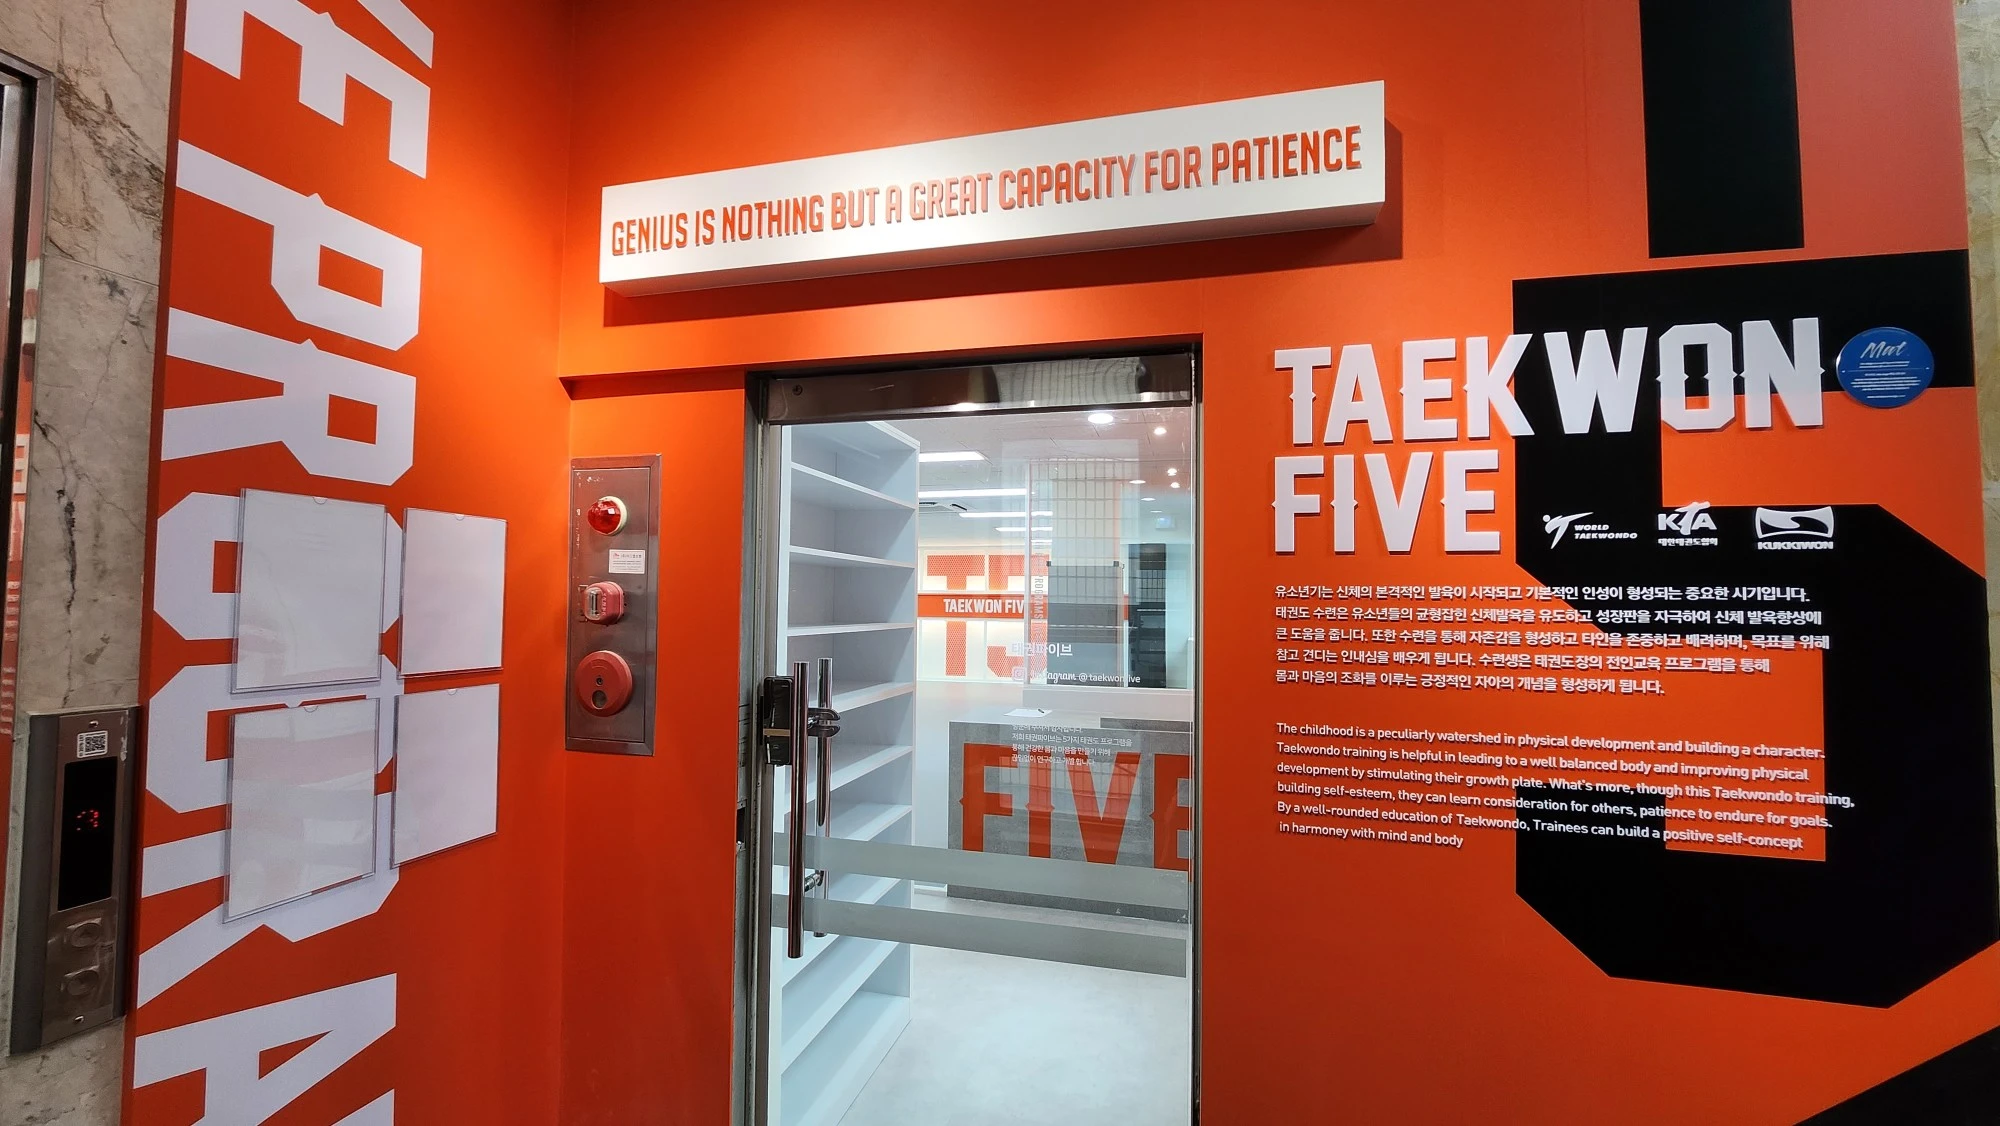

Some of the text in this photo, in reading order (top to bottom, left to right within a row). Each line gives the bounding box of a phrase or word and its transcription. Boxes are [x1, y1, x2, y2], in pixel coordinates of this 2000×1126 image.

[612, 125, 1362, 256] GENIUS IS NOTHING BUT A GREAT CAPACITY FOR PATIENCE
[1273, 317, 1826, 446] TAEKWON
[1271, 449, 1501, 555] FIVE
[1657, 501, 1717, 536] KTA
[1574, 532, 1638, 540] TAEKWONDO
[1757, 541, 1834, 550] KUKKIWON
[943, 598, 1025, 614] TAEKWON FIV
[1274, 584, 1811, 603] 유소년기는 신체의 본격적인 발육이 시작되고 기본적인 인성이 형성되는 중요한 시기입니다.
[1275, 606, 1822, 626] 태권도 수련은 유소년들의 균형잡힌 신체발육을 유도하고 성장판을 자극하여 신체 발육향상에
[1275, 627, 1830, 650] 큰 도움을 줍니다. 또한 수련을 통해 자존감을 형성하고 타인을 존중하고 배려하며, 목표를 위해
[1276, 648, 1300, 661] 참고
[1302, 649, 1338, 663] 견디는
[1340, 649, 1390, 664] 인내심을
[1392, 651, 1431, 665] 배우게
[1433, 652, 1476, 666] 됩니다.
[1478, 653, 1533, 668] 수련생은
[1605, 655, 1663, 671] 전인교육
[1664, 656, 1738, 672] 프로그램을
[1738, 657, 1770, 673] 통해
[1275, 669, 1665, 694] 몸과 마음의 조화를 이루는 긍정적인 자아의 개념을 형성하게 됩니다.
[1276, 722, 1826, 759] The childhood is a peculiarly watershed in physical development and building a character.
[1276, 741, 1809, 782] Taekwondo training is helpful in leading to a well balanced body and improving physical
[1277, 761, 1855, 809] development by stimulating their growth plate. What's more, though this Taekwondo training,
[1277, 781, 1833, 828] building self-esteem, they can learn consideration for others, patience to endure for goals.
[1277, 800, 1804, 851] By a well-rounded education of Taekwondo, Trainees can build a positive self-concept
[1279, 821, 1464, 849] in harmoney with mind and body
